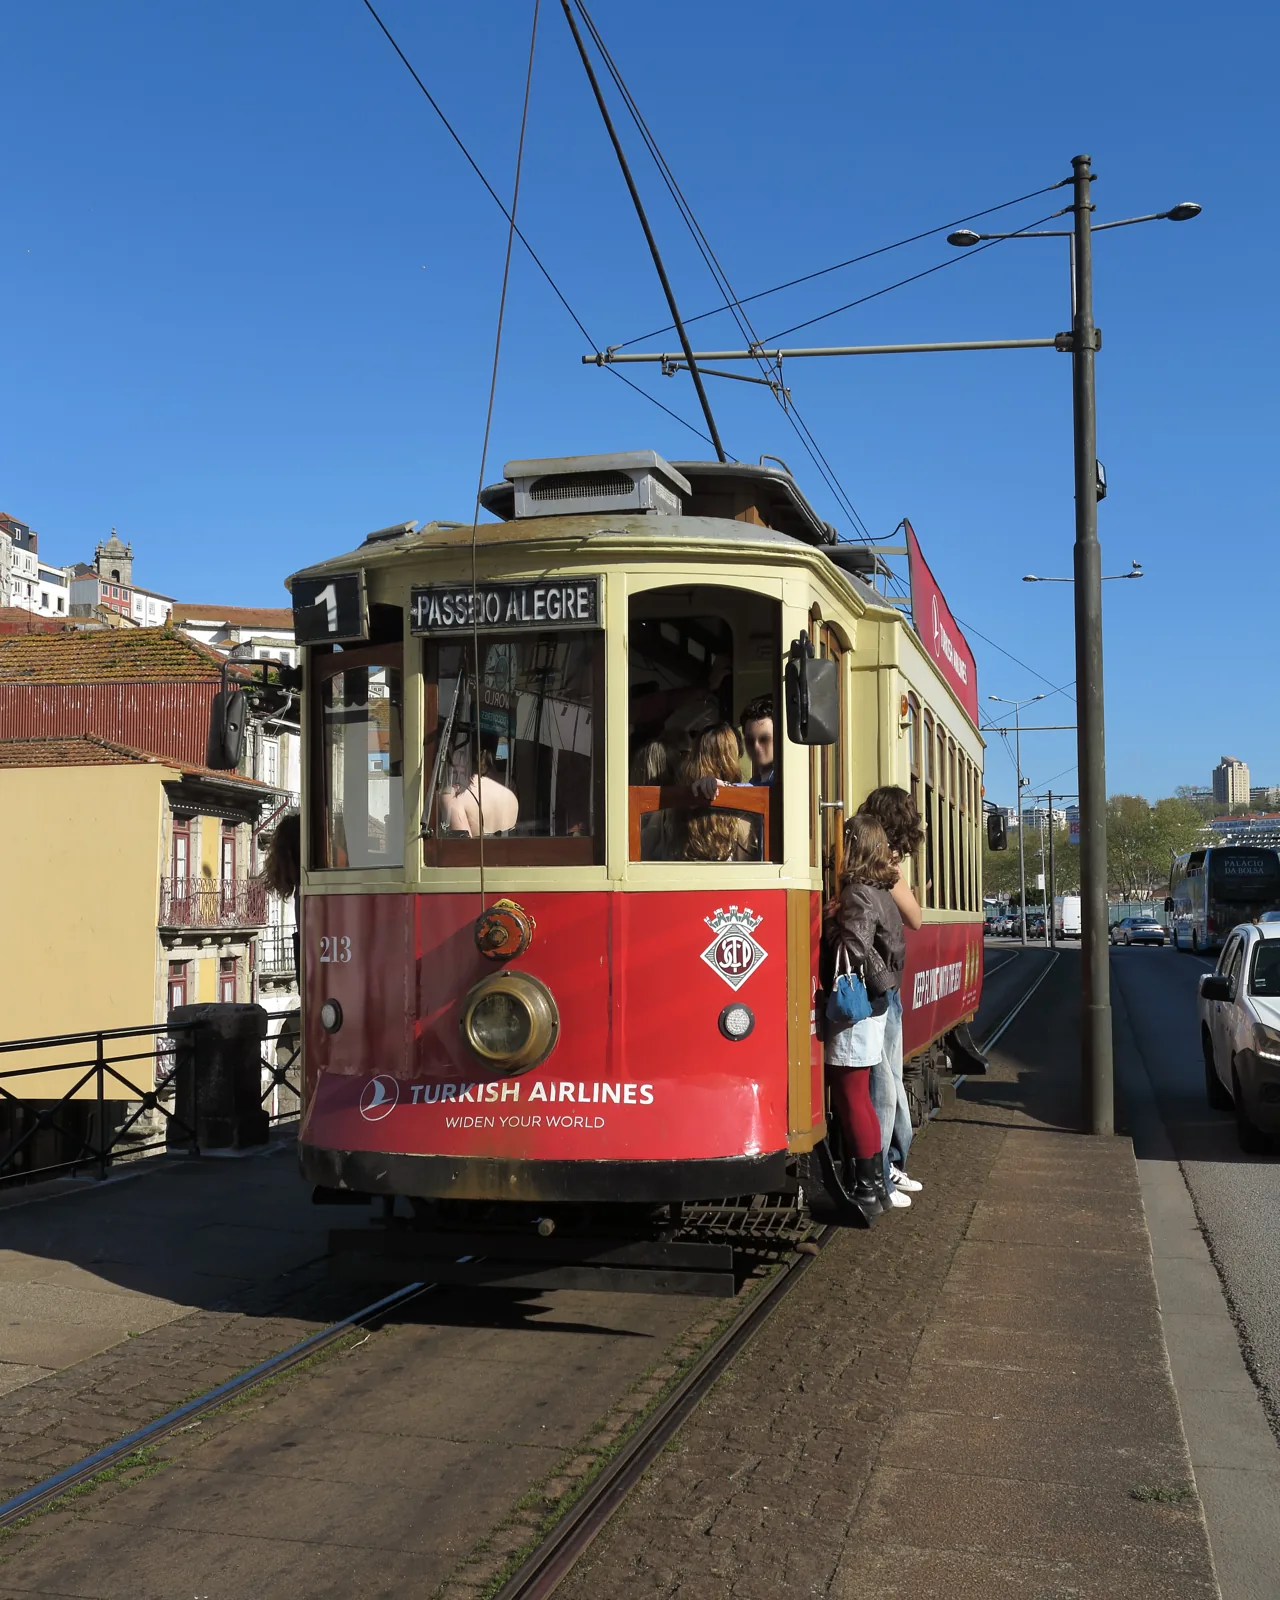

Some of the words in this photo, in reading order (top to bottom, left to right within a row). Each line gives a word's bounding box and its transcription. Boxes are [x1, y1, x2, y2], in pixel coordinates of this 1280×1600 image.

[314, 584, 338, 632] 1
[417, 592, 501, 626] PASSEIO
[505, 588, 589, 621] ALEGRE
[320, 936, 352, 963] 213
[410, 1082, 520, 1105] TURKISH
[528, 1083, 655, 1105] AIRLINES
[445, 1116, 495, 1128] WIDEN
[499, 1116, 541, 1128] YOUR
[546, 1116, 605, 1128] WORLD
